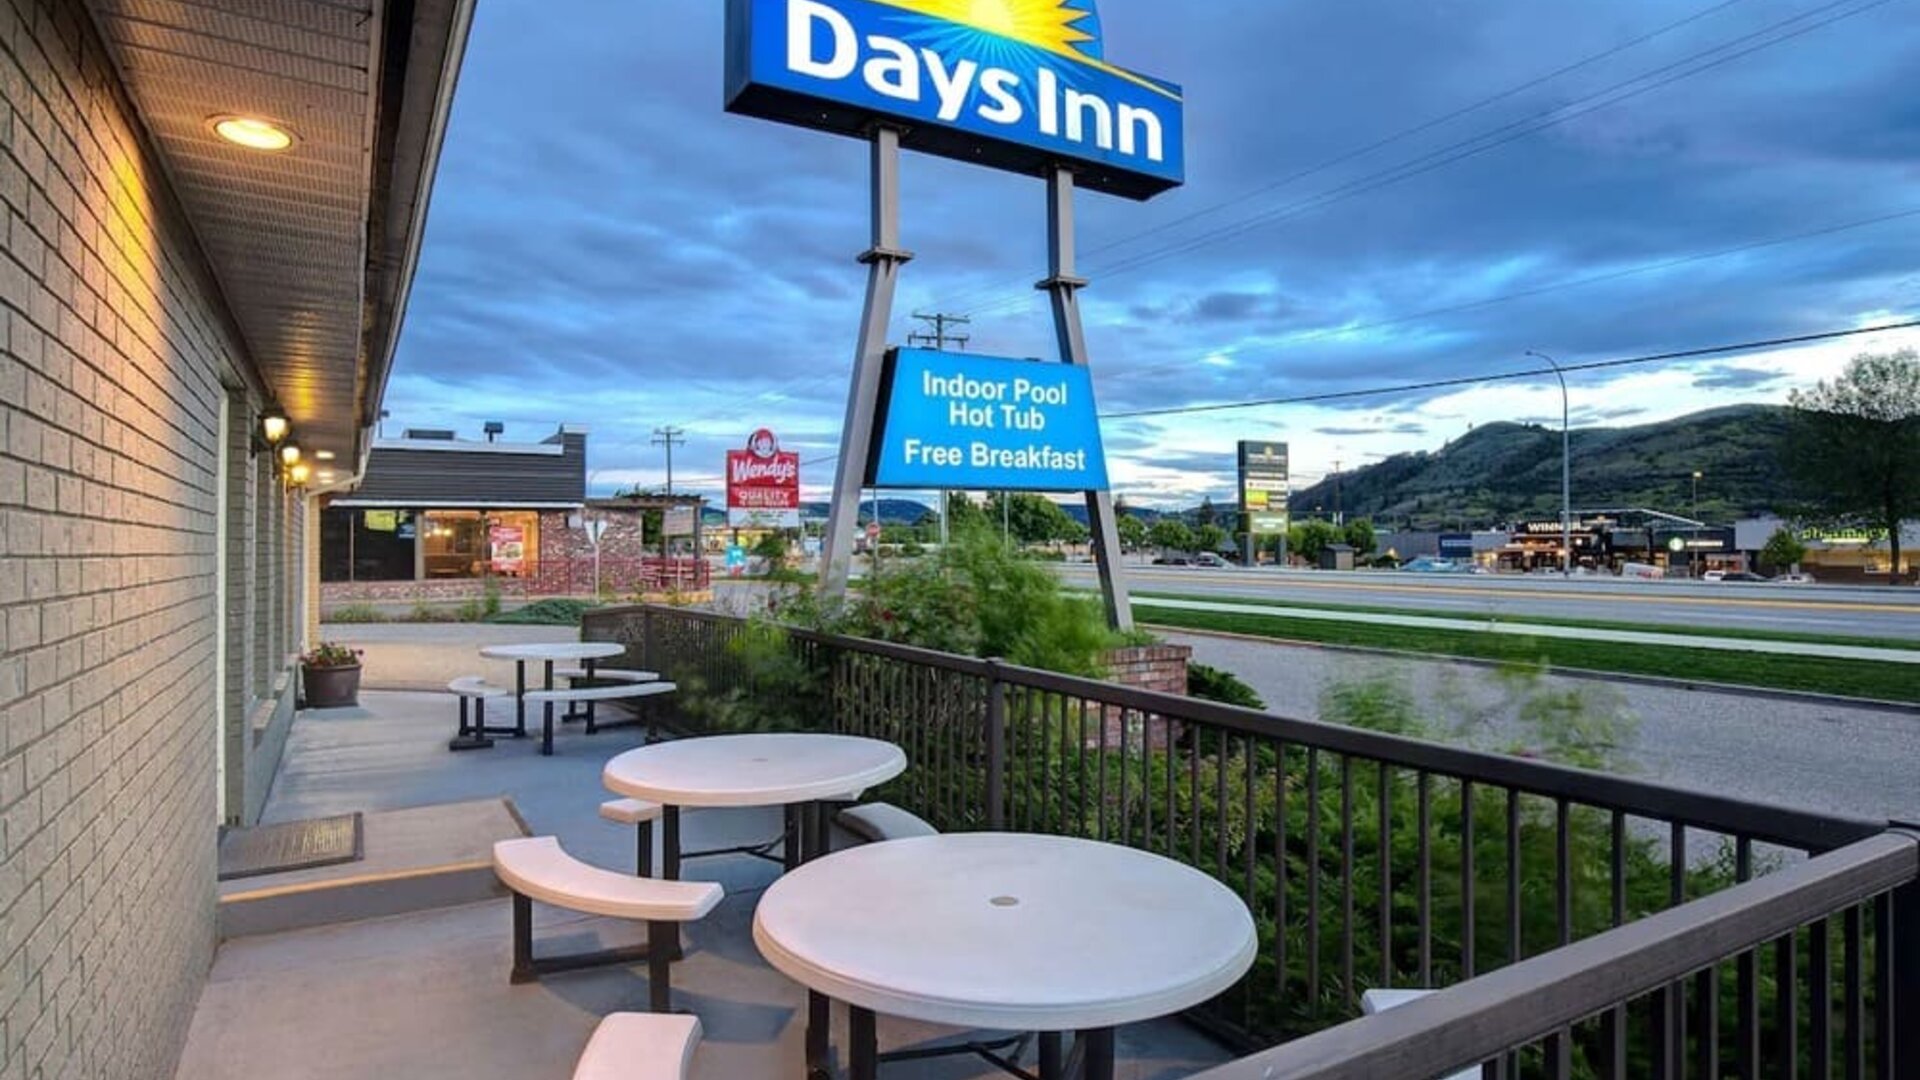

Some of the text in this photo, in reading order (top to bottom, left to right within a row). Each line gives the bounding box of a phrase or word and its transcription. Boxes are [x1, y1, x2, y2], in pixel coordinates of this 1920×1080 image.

[787, 0, 1164, 162] Days Inn
[922, 370, 1067, 405] Indoor Pool
[949, 402, 1045, 430] Hot Tub
[732, 453, 796, 483] Wendy's
[904, 439, 1086, 471] Free Breakfast
